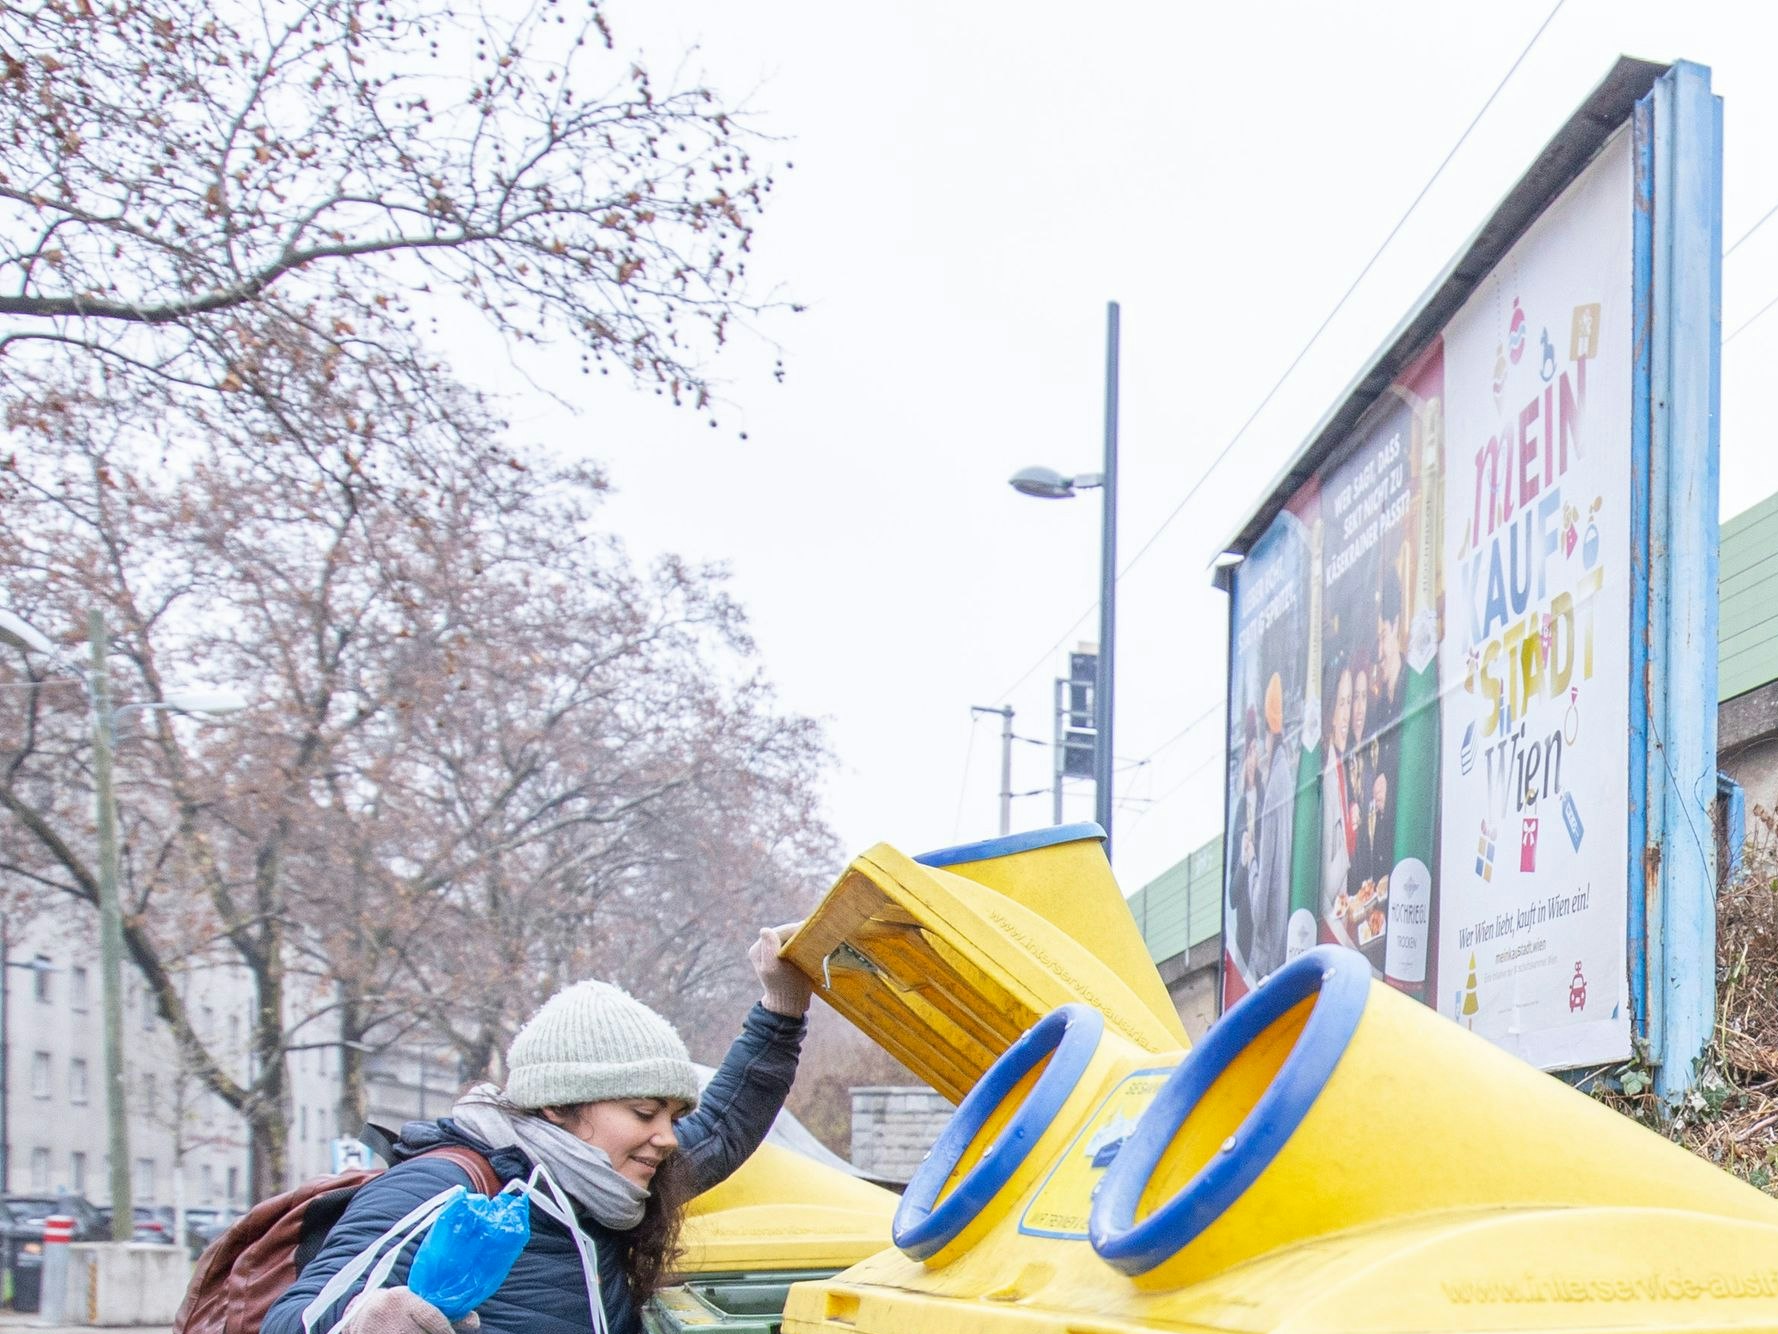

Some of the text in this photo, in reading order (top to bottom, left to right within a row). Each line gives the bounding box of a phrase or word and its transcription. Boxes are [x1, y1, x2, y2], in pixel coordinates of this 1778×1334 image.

[1377, 432, 1400, 474] DASS
[1364, 477, 1389, 520] NICHT
[1461, 489, 1561, 649] KAUF
[1480, 566, 1604, 737] STADT
[1484, 722, 1562, 819] Wien
[1392, 903, 1426, 925] HOCHRIEGL
[1458, 882, 1590, 949] Wer Wien liebt, kauft in Wien ein!
